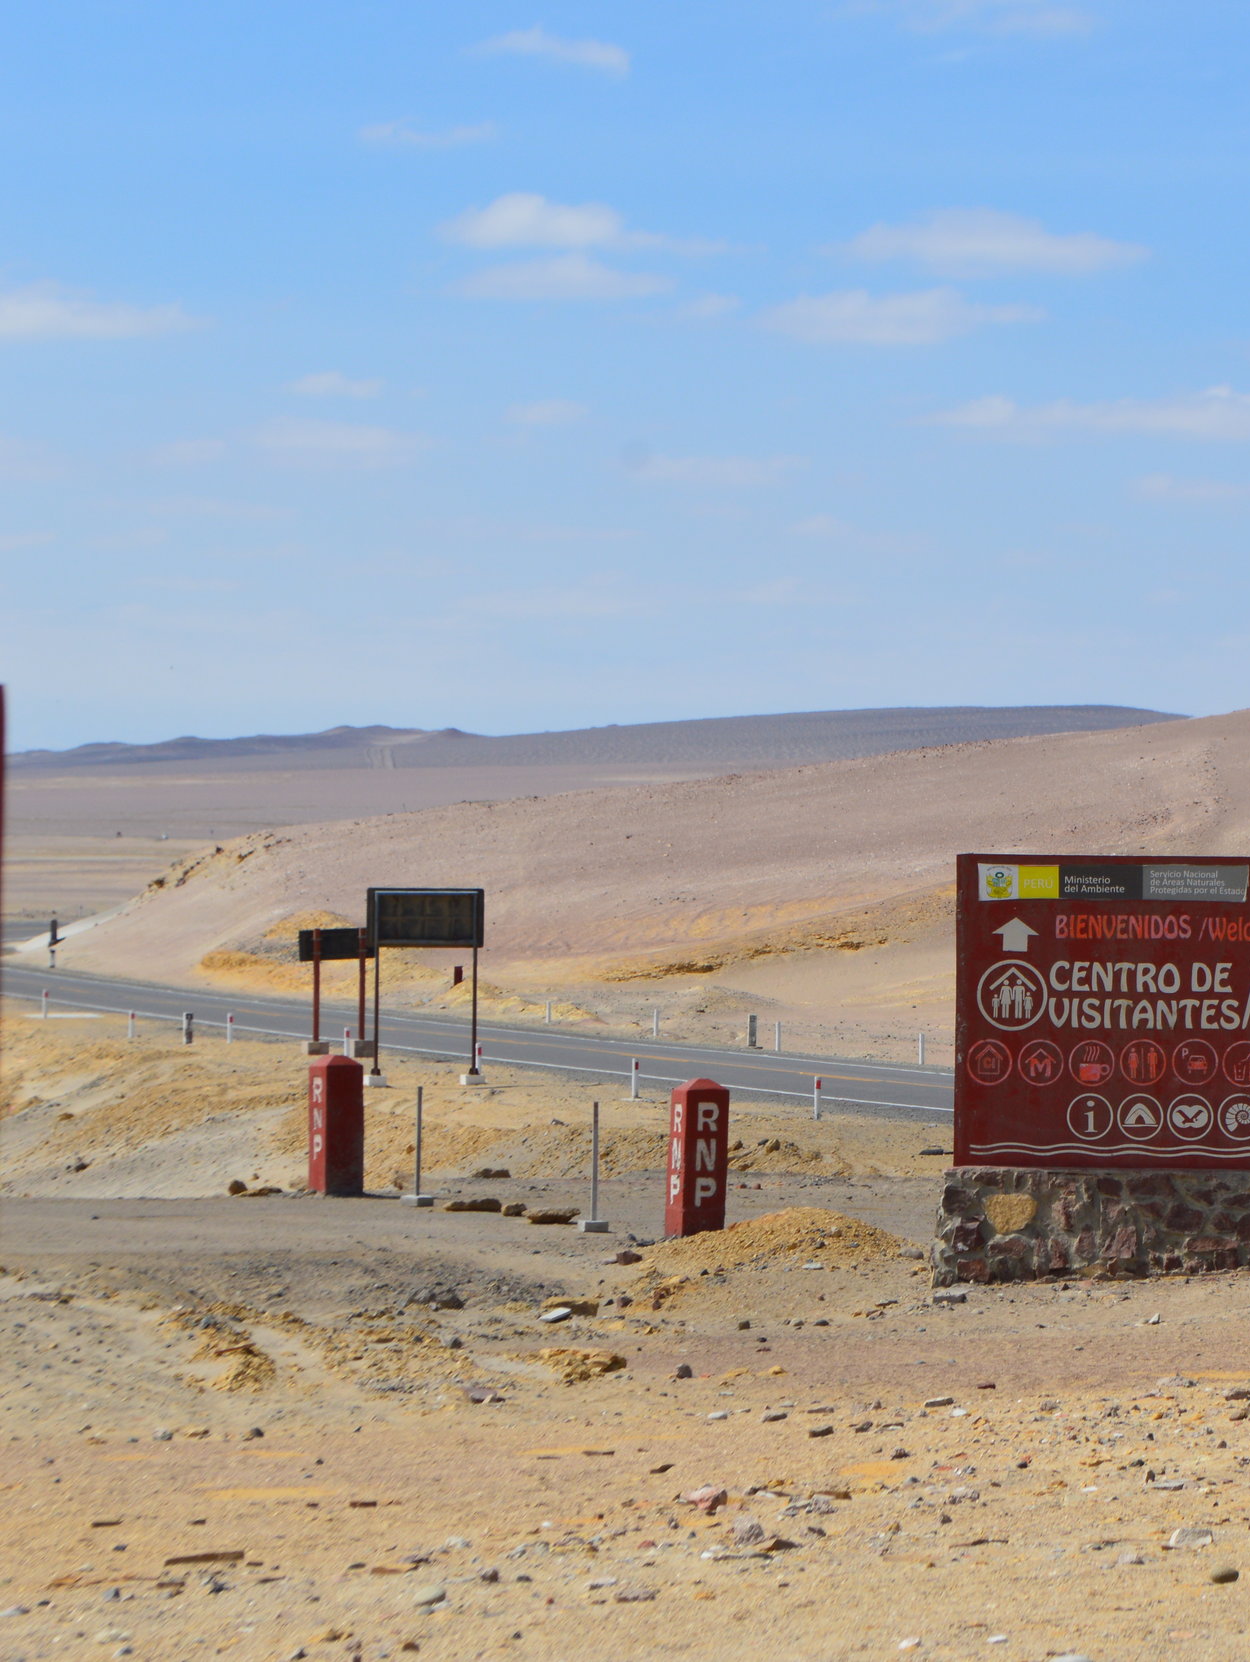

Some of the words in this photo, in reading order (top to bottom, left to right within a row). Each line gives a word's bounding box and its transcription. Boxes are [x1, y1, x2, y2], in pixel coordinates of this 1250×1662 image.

[1064, 876, 1111, 884] Ministerio
[1150, 870, 1181, 878] Servicio
[1184, 870, 1218, 878] Nacional
[1023, 877, 1054, 889] PERÚ
[1150, 878, 1160, 886] de
[1187, 878, 1225, 887] Naturales
[1064, 885, 1078, 893] del
[1081, 885, 1125, 893] Ambiente
[1150, 887, 1192, 895] Protegidas
[1195, 887, 1207, 895] por
[1055, 915, 1192, 939] BIENVENIDOS
[1049, 960, 1181, 994] CENTRO
[1191, 962, 1233, 993] DE
[1049, 998, 1241, 1031] VISITANTES
[1181, 1048, 1189, 1057] P
[312, 1076, 323, 1161] RNP
[669, 1103, 683, 1206] RNP
[694, 1102, 720, 1208] RNP
